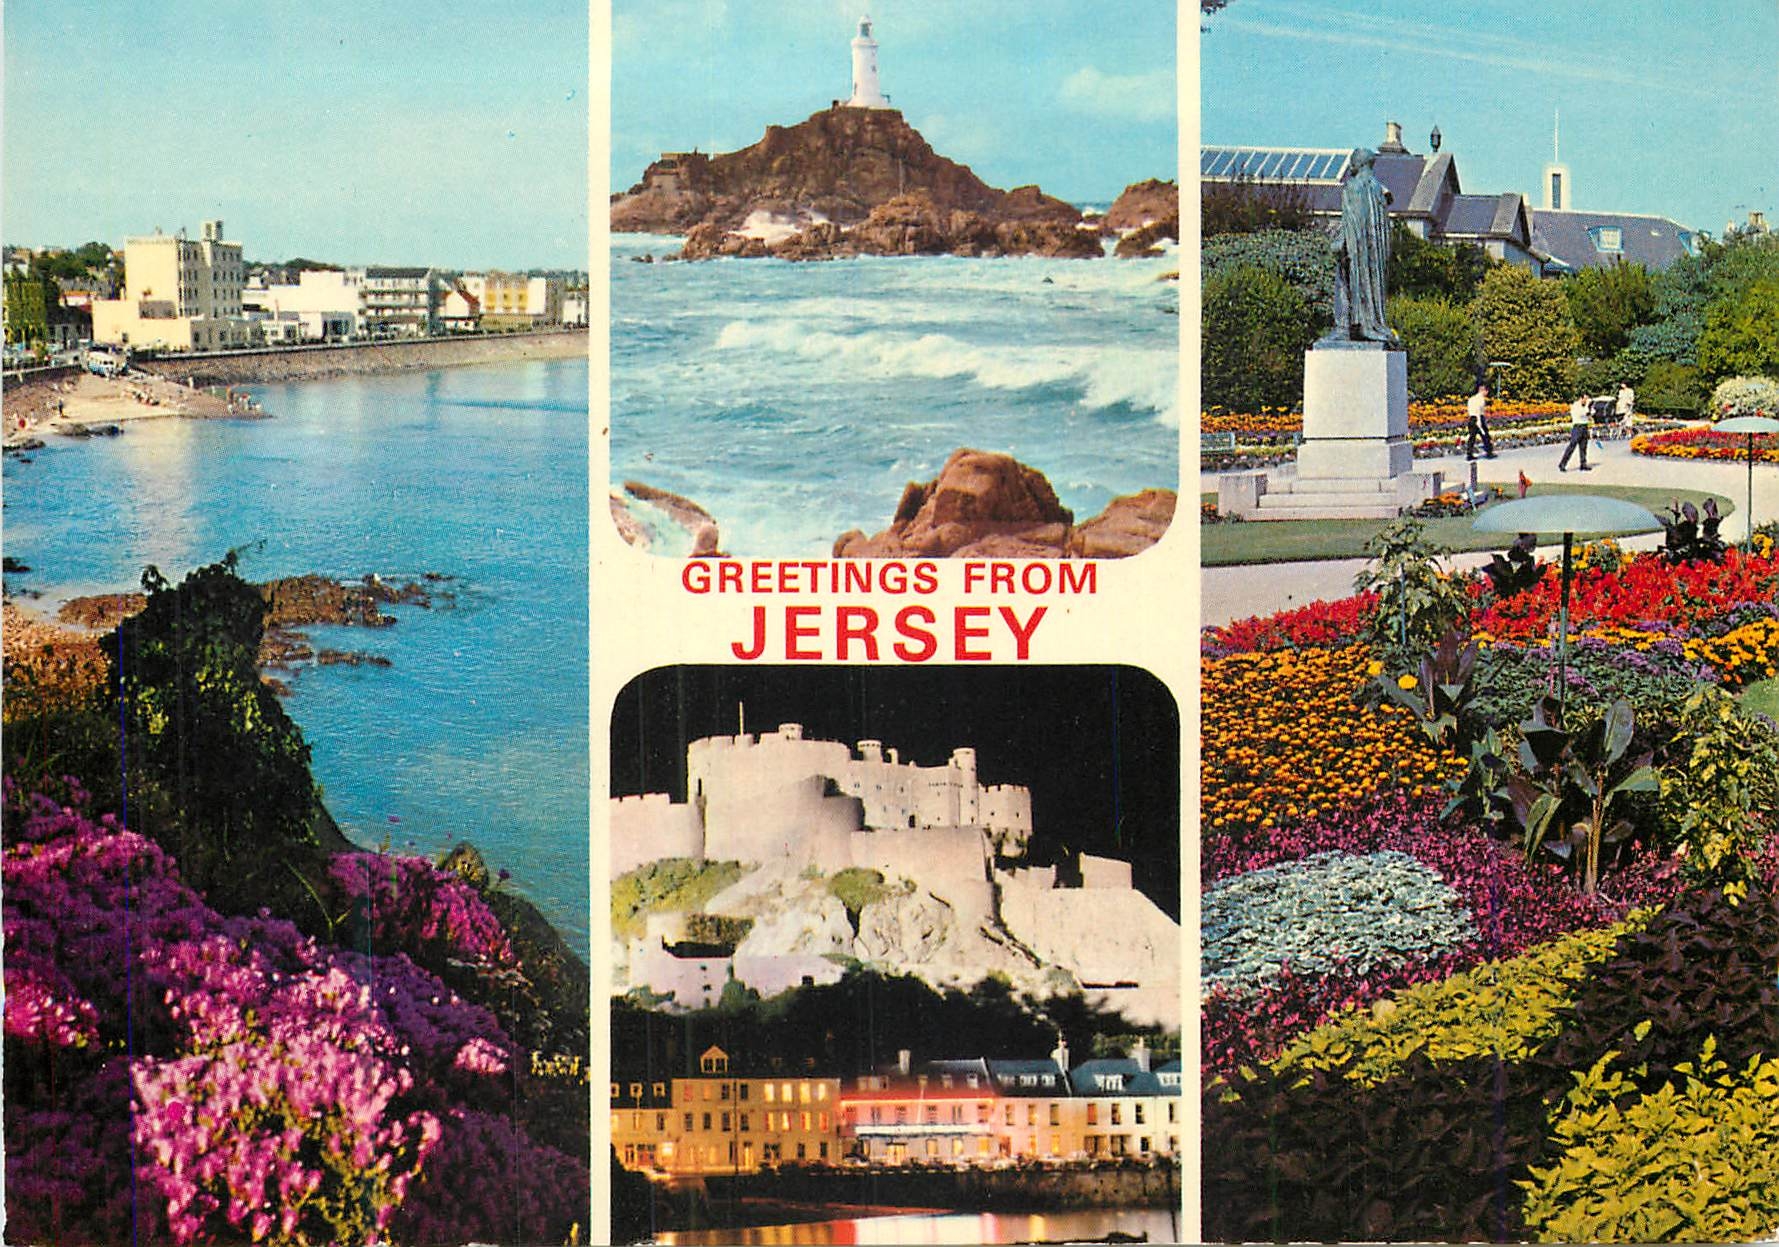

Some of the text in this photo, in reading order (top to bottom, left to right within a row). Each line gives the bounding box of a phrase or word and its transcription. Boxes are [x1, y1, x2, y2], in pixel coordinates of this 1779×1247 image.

[682, 562, 1098, 594] GREETINGS FROM
[731, 605, 1049, 662] JERSEY
